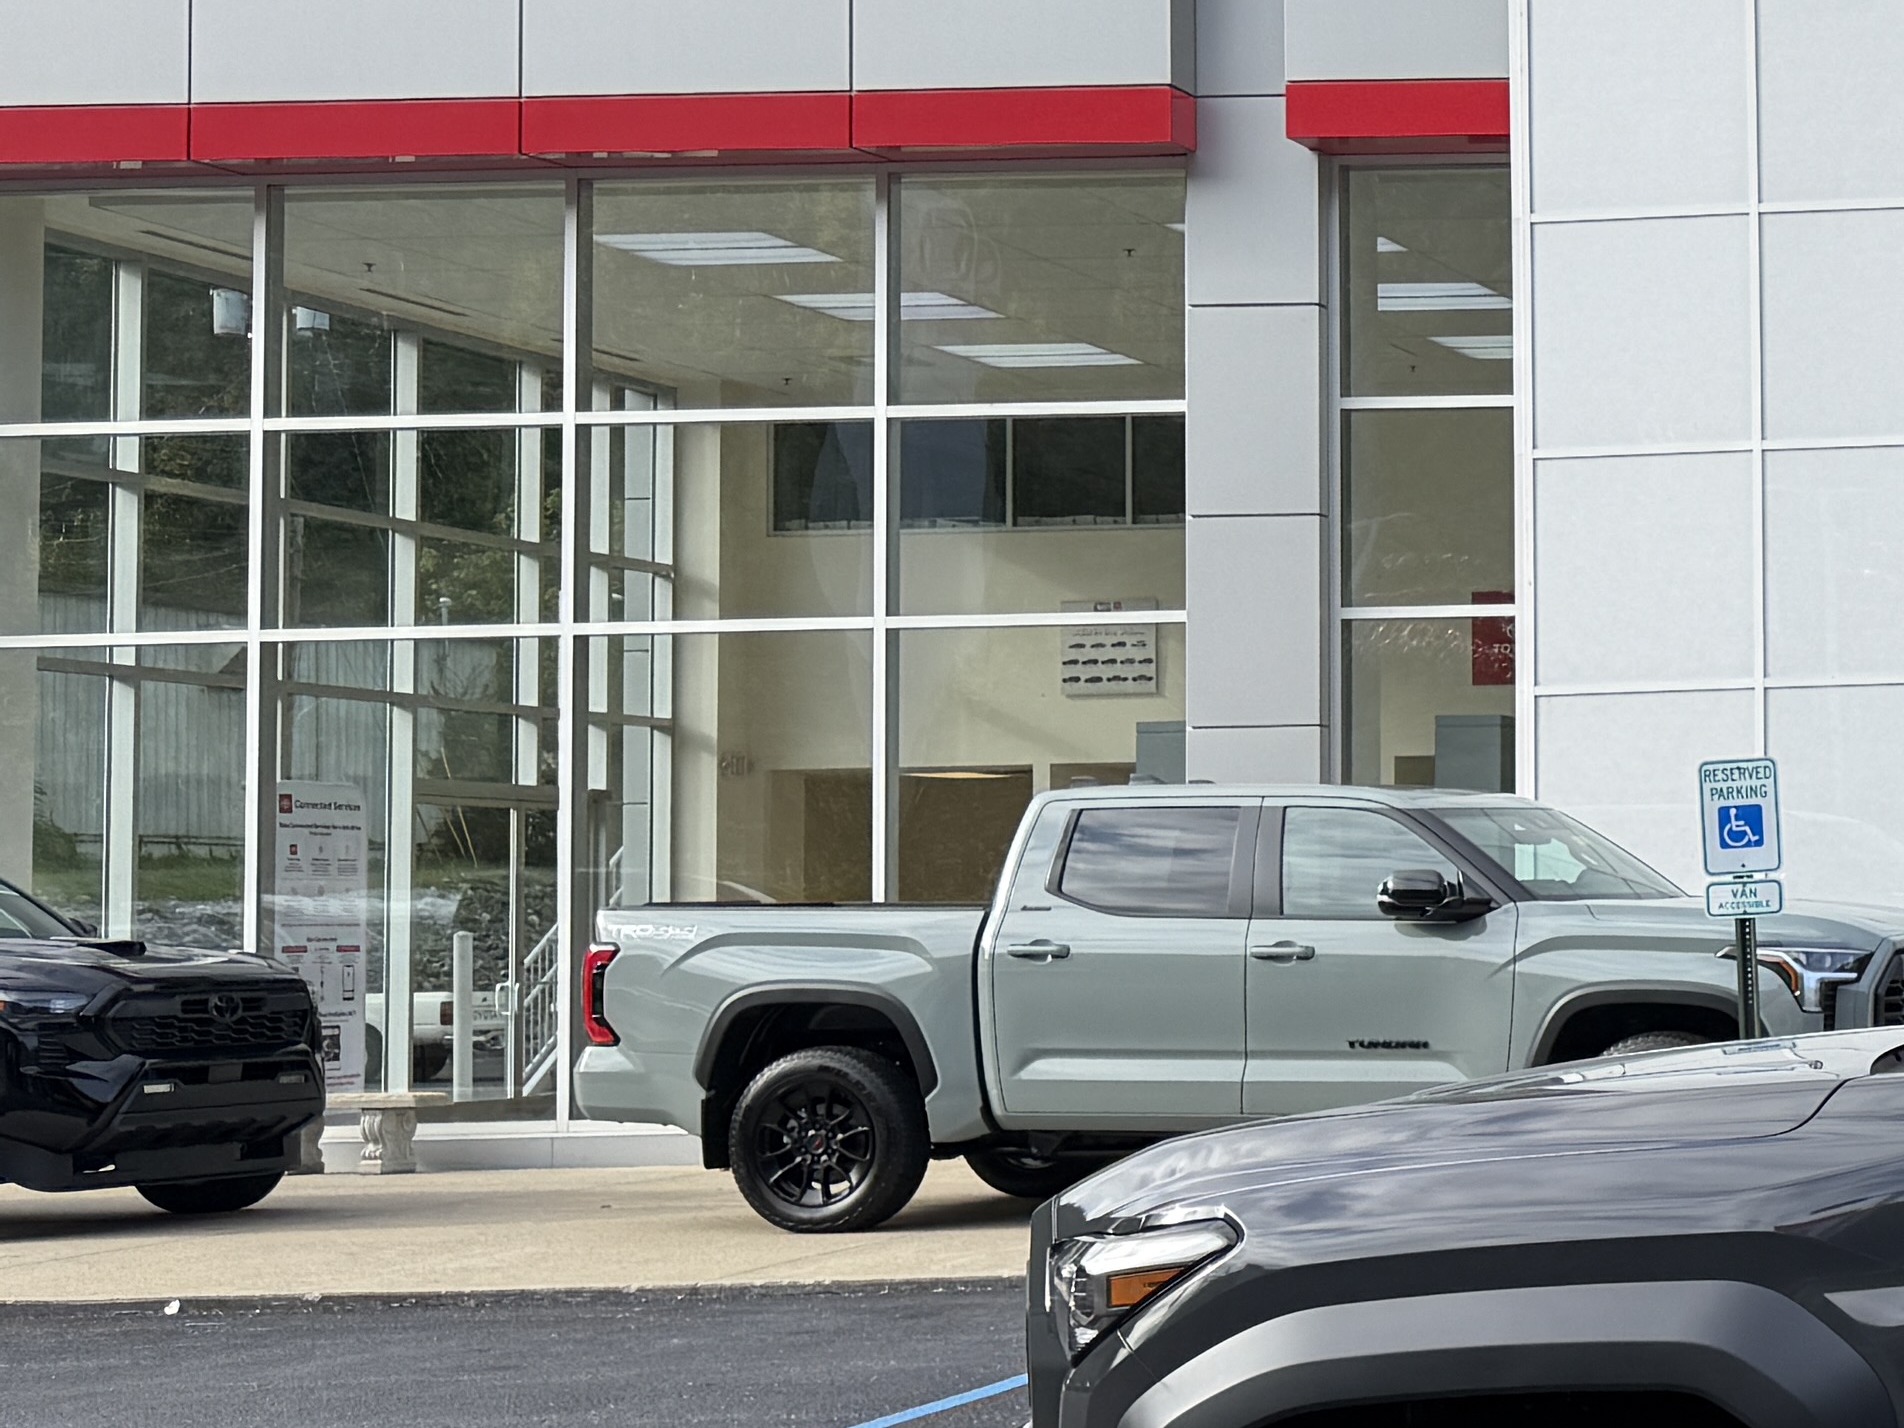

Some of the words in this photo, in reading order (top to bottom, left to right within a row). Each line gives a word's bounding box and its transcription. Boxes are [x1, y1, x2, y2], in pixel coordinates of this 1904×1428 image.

[1703, 765, 1772, 783] RESERVED
[1710, 784, 1768, 801] PARKING
[1731, 887, 1758, 900] VAN
[1718, 899, 1772, 911] ACCESSIBLE
